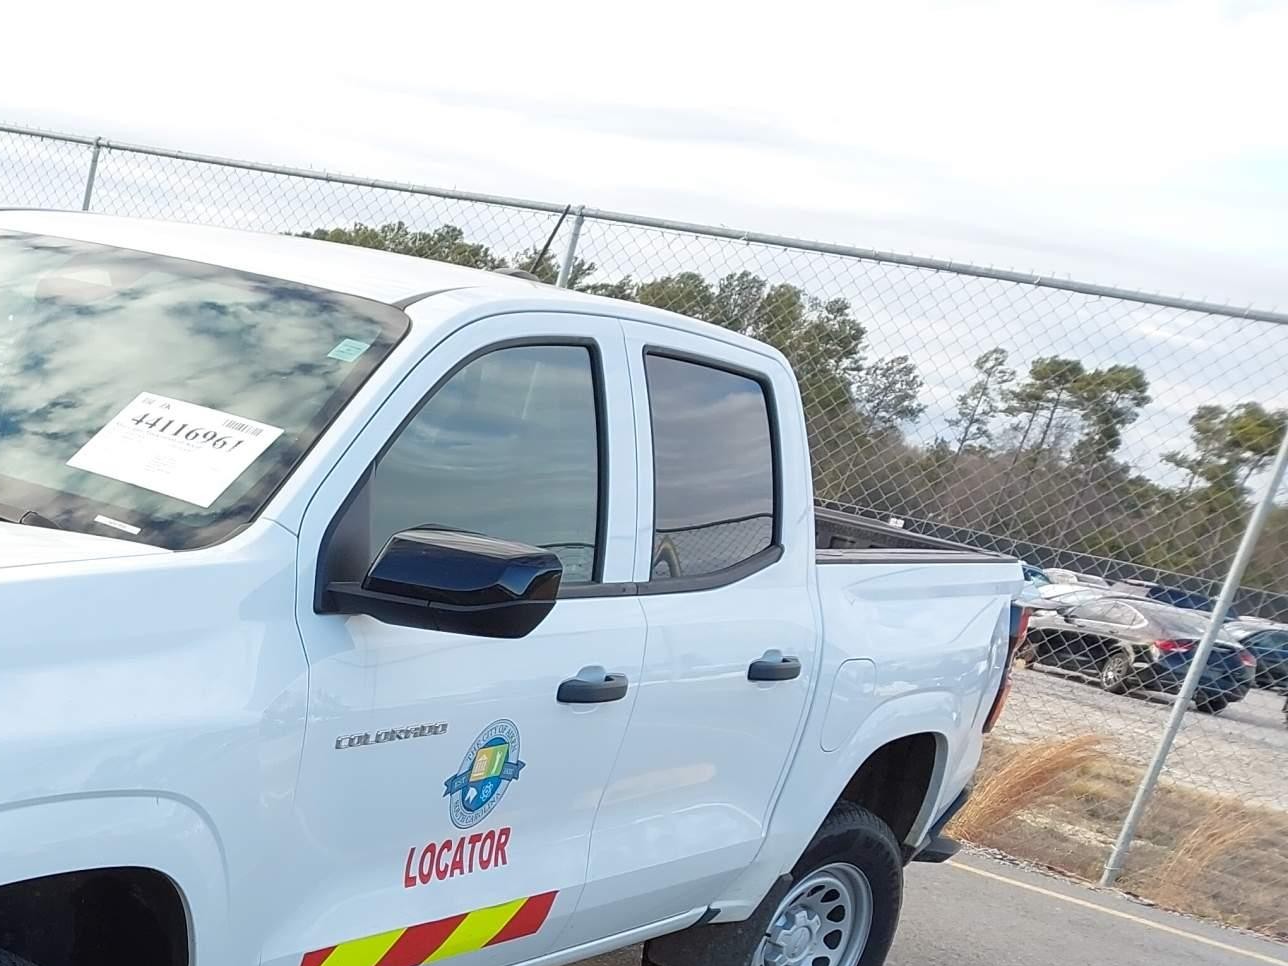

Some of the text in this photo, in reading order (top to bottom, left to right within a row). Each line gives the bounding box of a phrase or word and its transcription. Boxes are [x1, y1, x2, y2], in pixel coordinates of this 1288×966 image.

[131, 412, 245, 452] 44116961
[335, 722, 449, 749] COLORADO
[404, 827, 511, 888] LOCATOR
